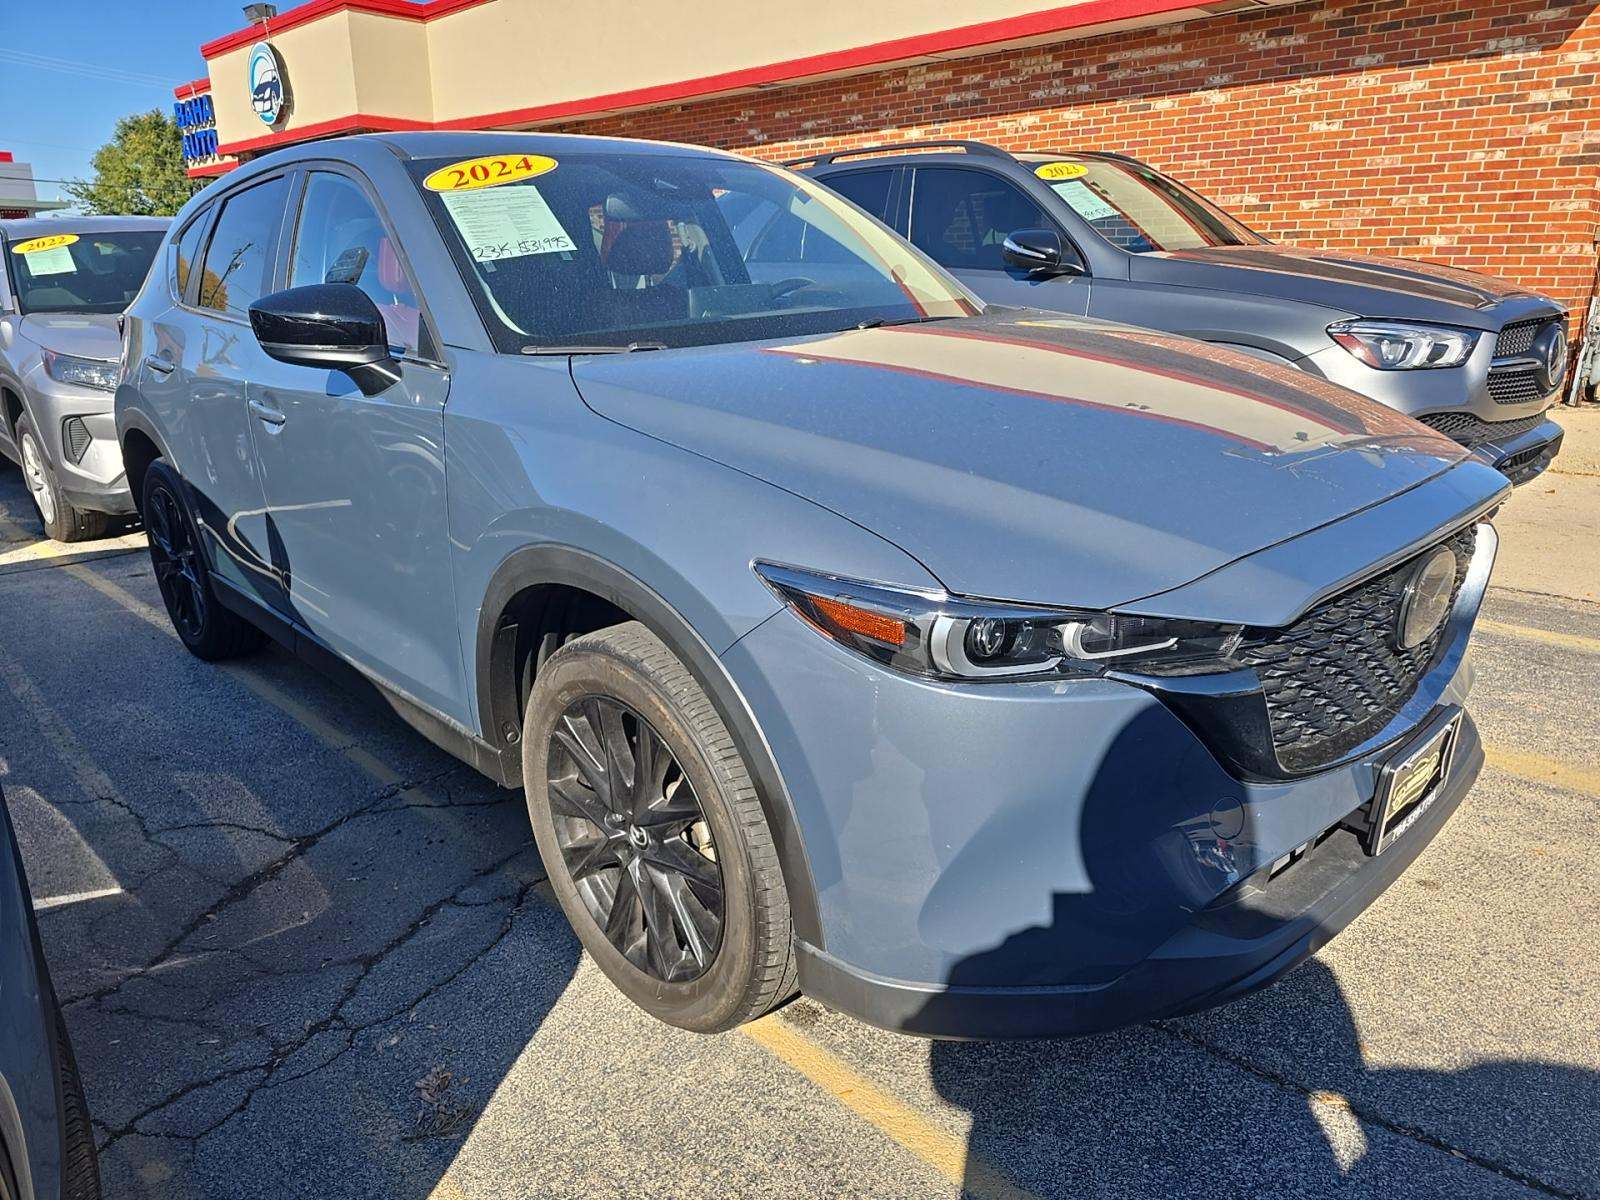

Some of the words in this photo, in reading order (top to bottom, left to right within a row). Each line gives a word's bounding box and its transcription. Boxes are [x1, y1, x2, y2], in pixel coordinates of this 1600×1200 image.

[174, 94, 215, 128] BAHA
[183, 129, 218, 160] AUTO
[448, 157, 534, 188] 2024
[1045, 165, 1080, 178] 2023
[26, 236, 67, 251] 2022
[472, 242, 513, 258] 23K
[518, 236, 569, 253] $31,995
